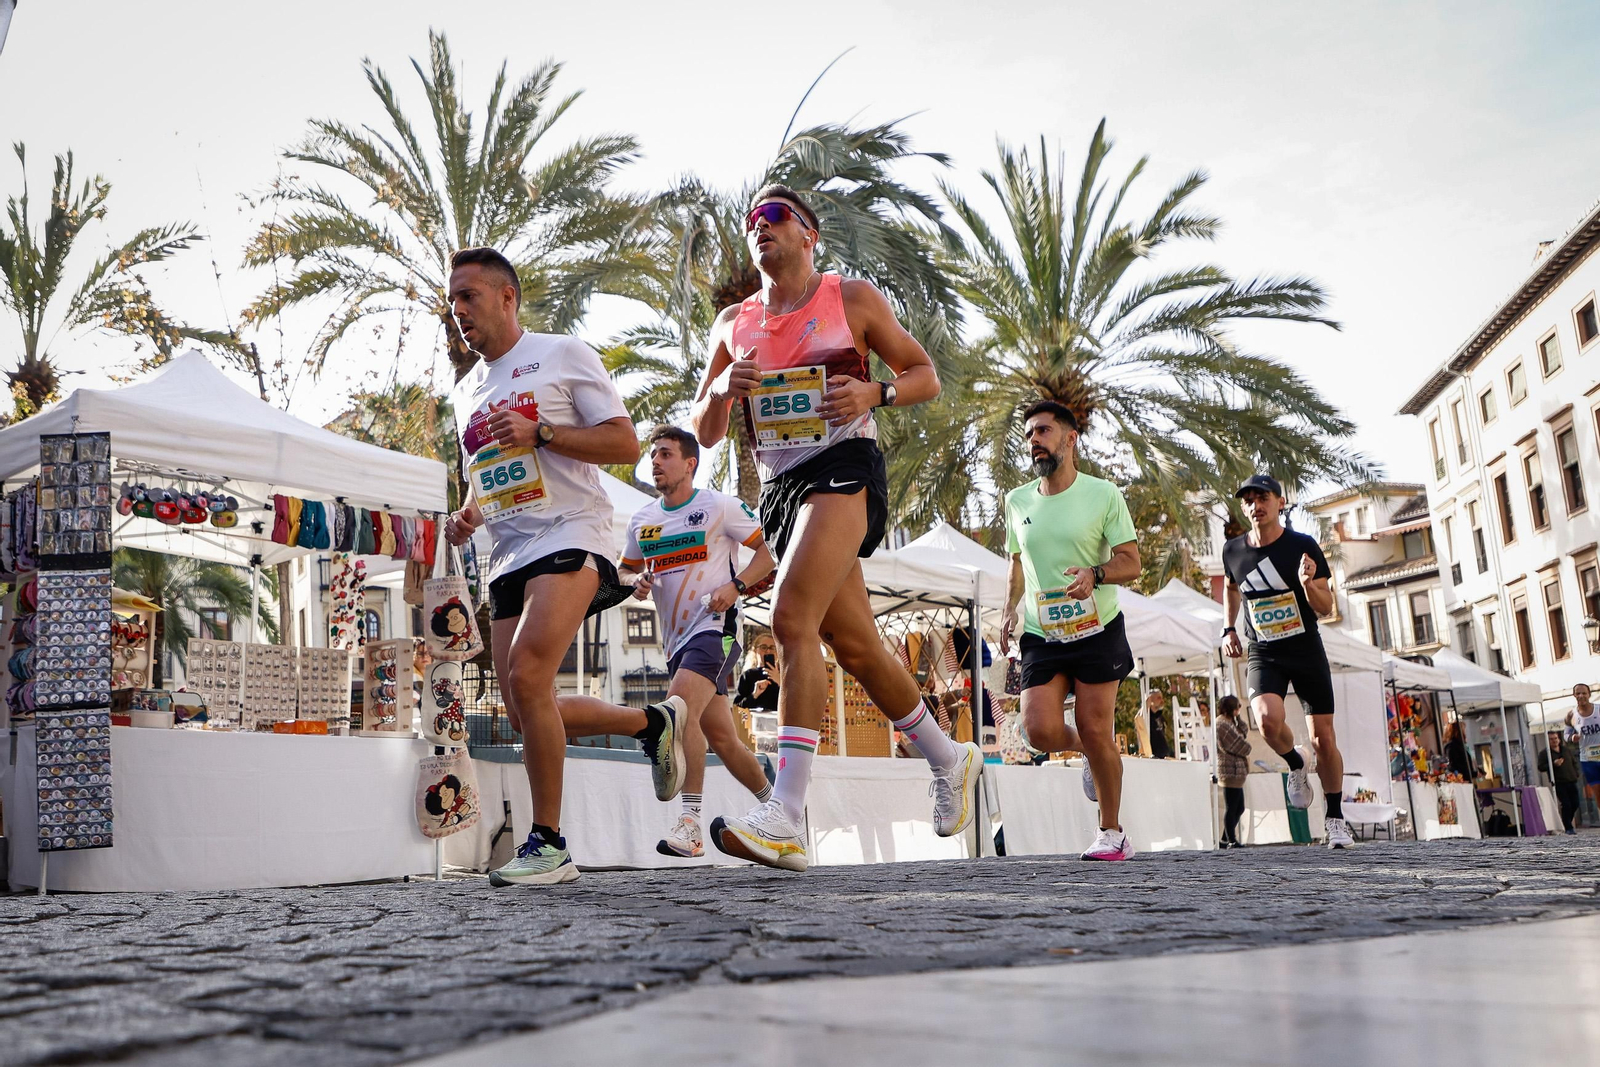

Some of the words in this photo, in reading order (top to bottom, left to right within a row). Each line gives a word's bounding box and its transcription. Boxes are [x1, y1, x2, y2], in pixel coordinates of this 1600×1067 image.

[760, 393, 811, 417] 258
[480, 461, 527, 491] 566
[1048, 601, 1086, 621] 591
[1254, 607, 1295, 624] 1001
